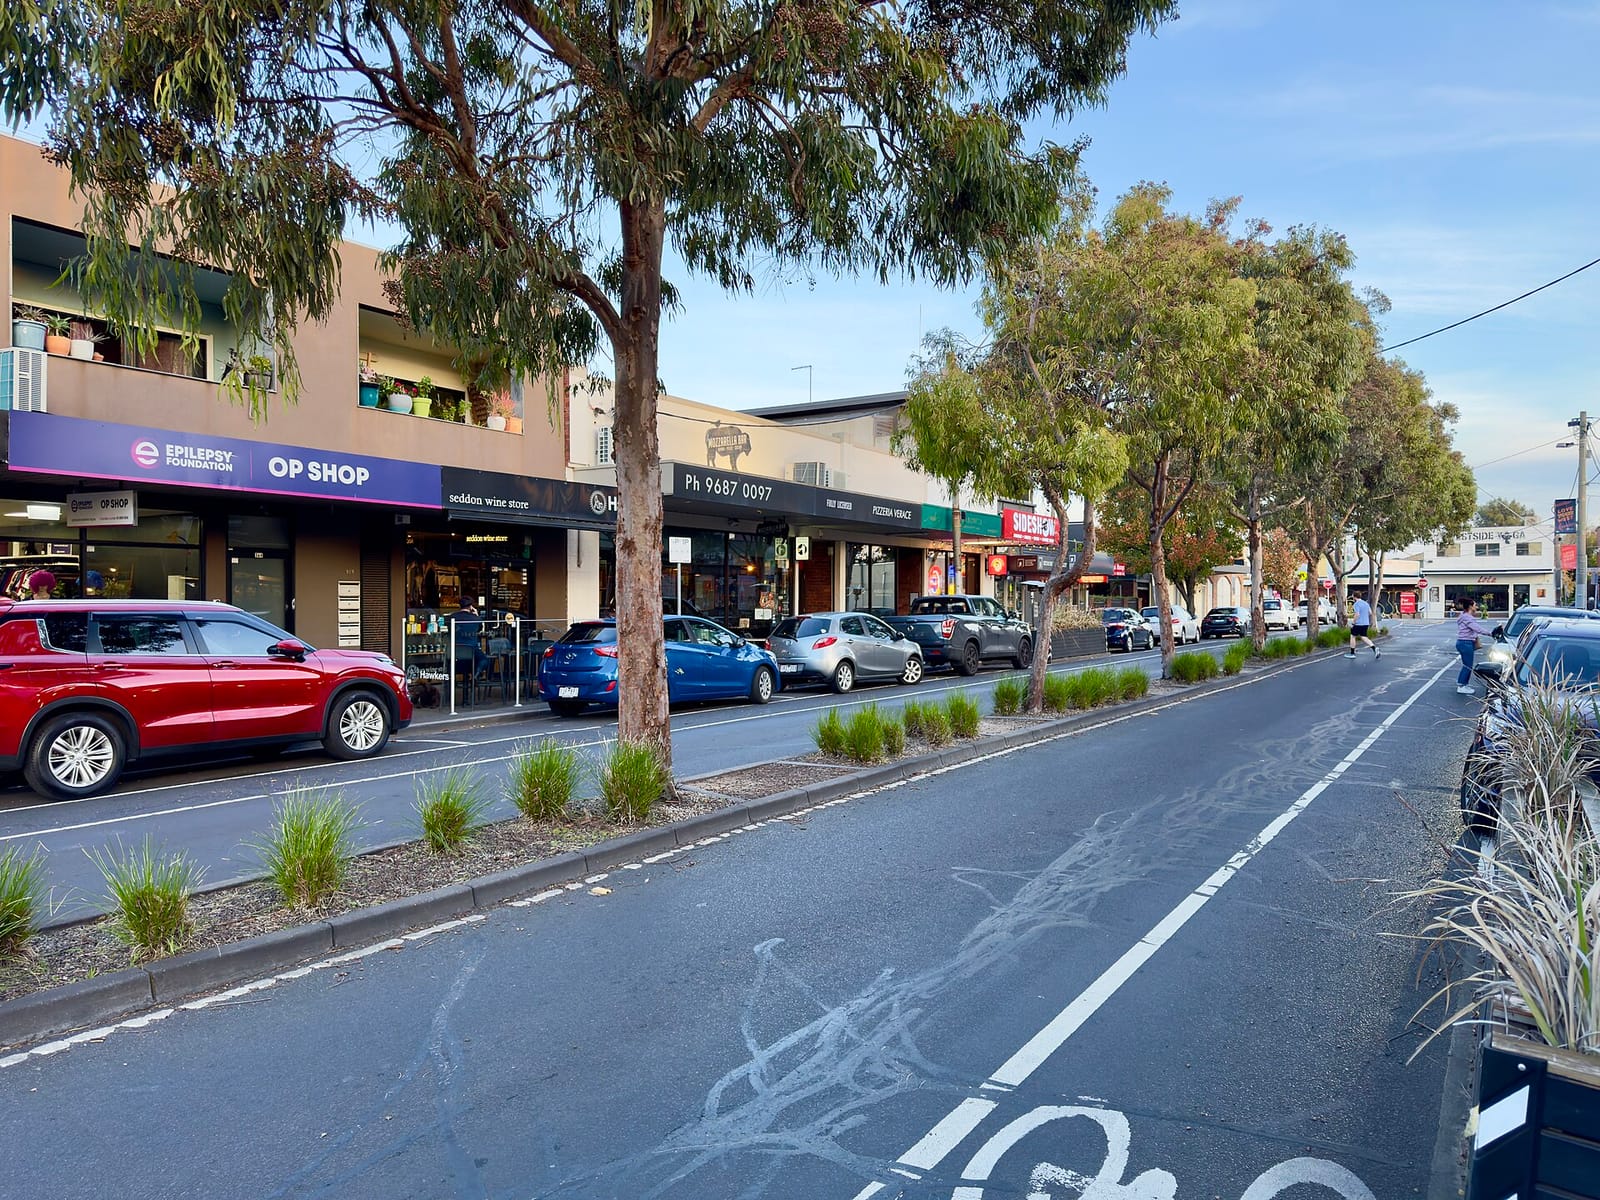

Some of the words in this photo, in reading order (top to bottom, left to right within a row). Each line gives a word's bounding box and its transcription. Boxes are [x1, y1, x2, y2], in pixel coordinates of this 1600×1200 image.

[165, 444, 233, 463] EPILEPSY
[166, 457, 233, 472] FOUNDATION
[268, 456, 304, 479] OP
[307, 461, 370, 486] SHOP
[685, 474, 700, 492] Ph
[705, 477, 738, 496] 9687
[742, 483, 772, 502] 0097
[100, 500, 110, 509] OP
[110, 498, 129, 509] SHOP
[449, 493, 483, 505] seddon
[485, 496, 507, 508] wine
[508, 500, 529, 510] store
[872, 505, 893, 517] PIZZERIA
[893, 508, 912, 520] VERACE
[1013, 511, 1056, 537] SIDESHOW
[419, 670, 450, 681] Hawkers
